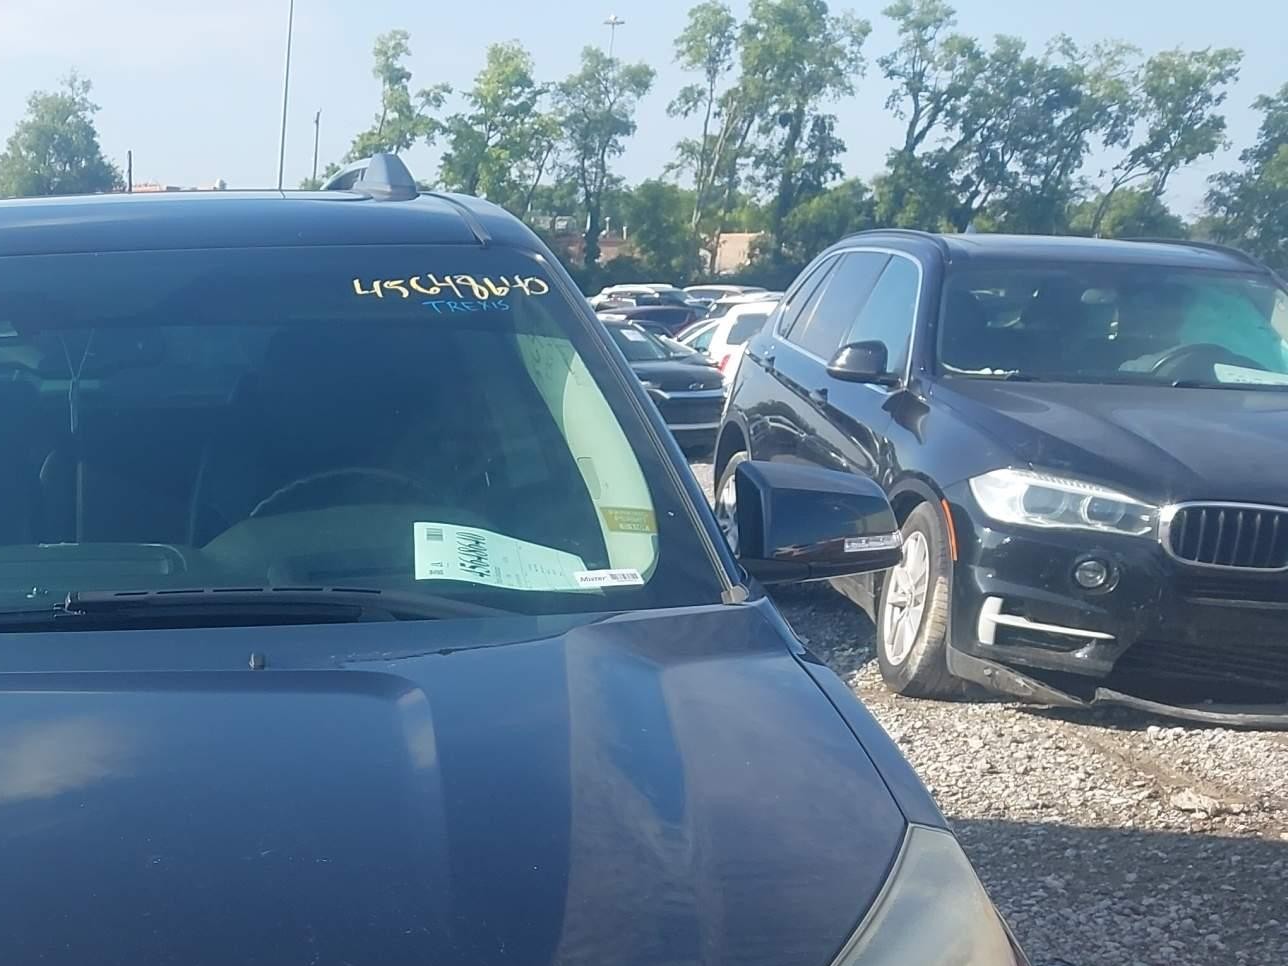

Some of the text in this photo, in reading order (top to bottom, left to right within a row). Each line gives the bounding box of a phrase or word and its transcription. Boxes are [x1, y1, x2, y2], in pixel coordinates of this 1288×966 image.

[353, 274, 549, 300] 45648640
[422, 300, 510, 313] TREXIS
[455, 531, 491, 578] 45648640
